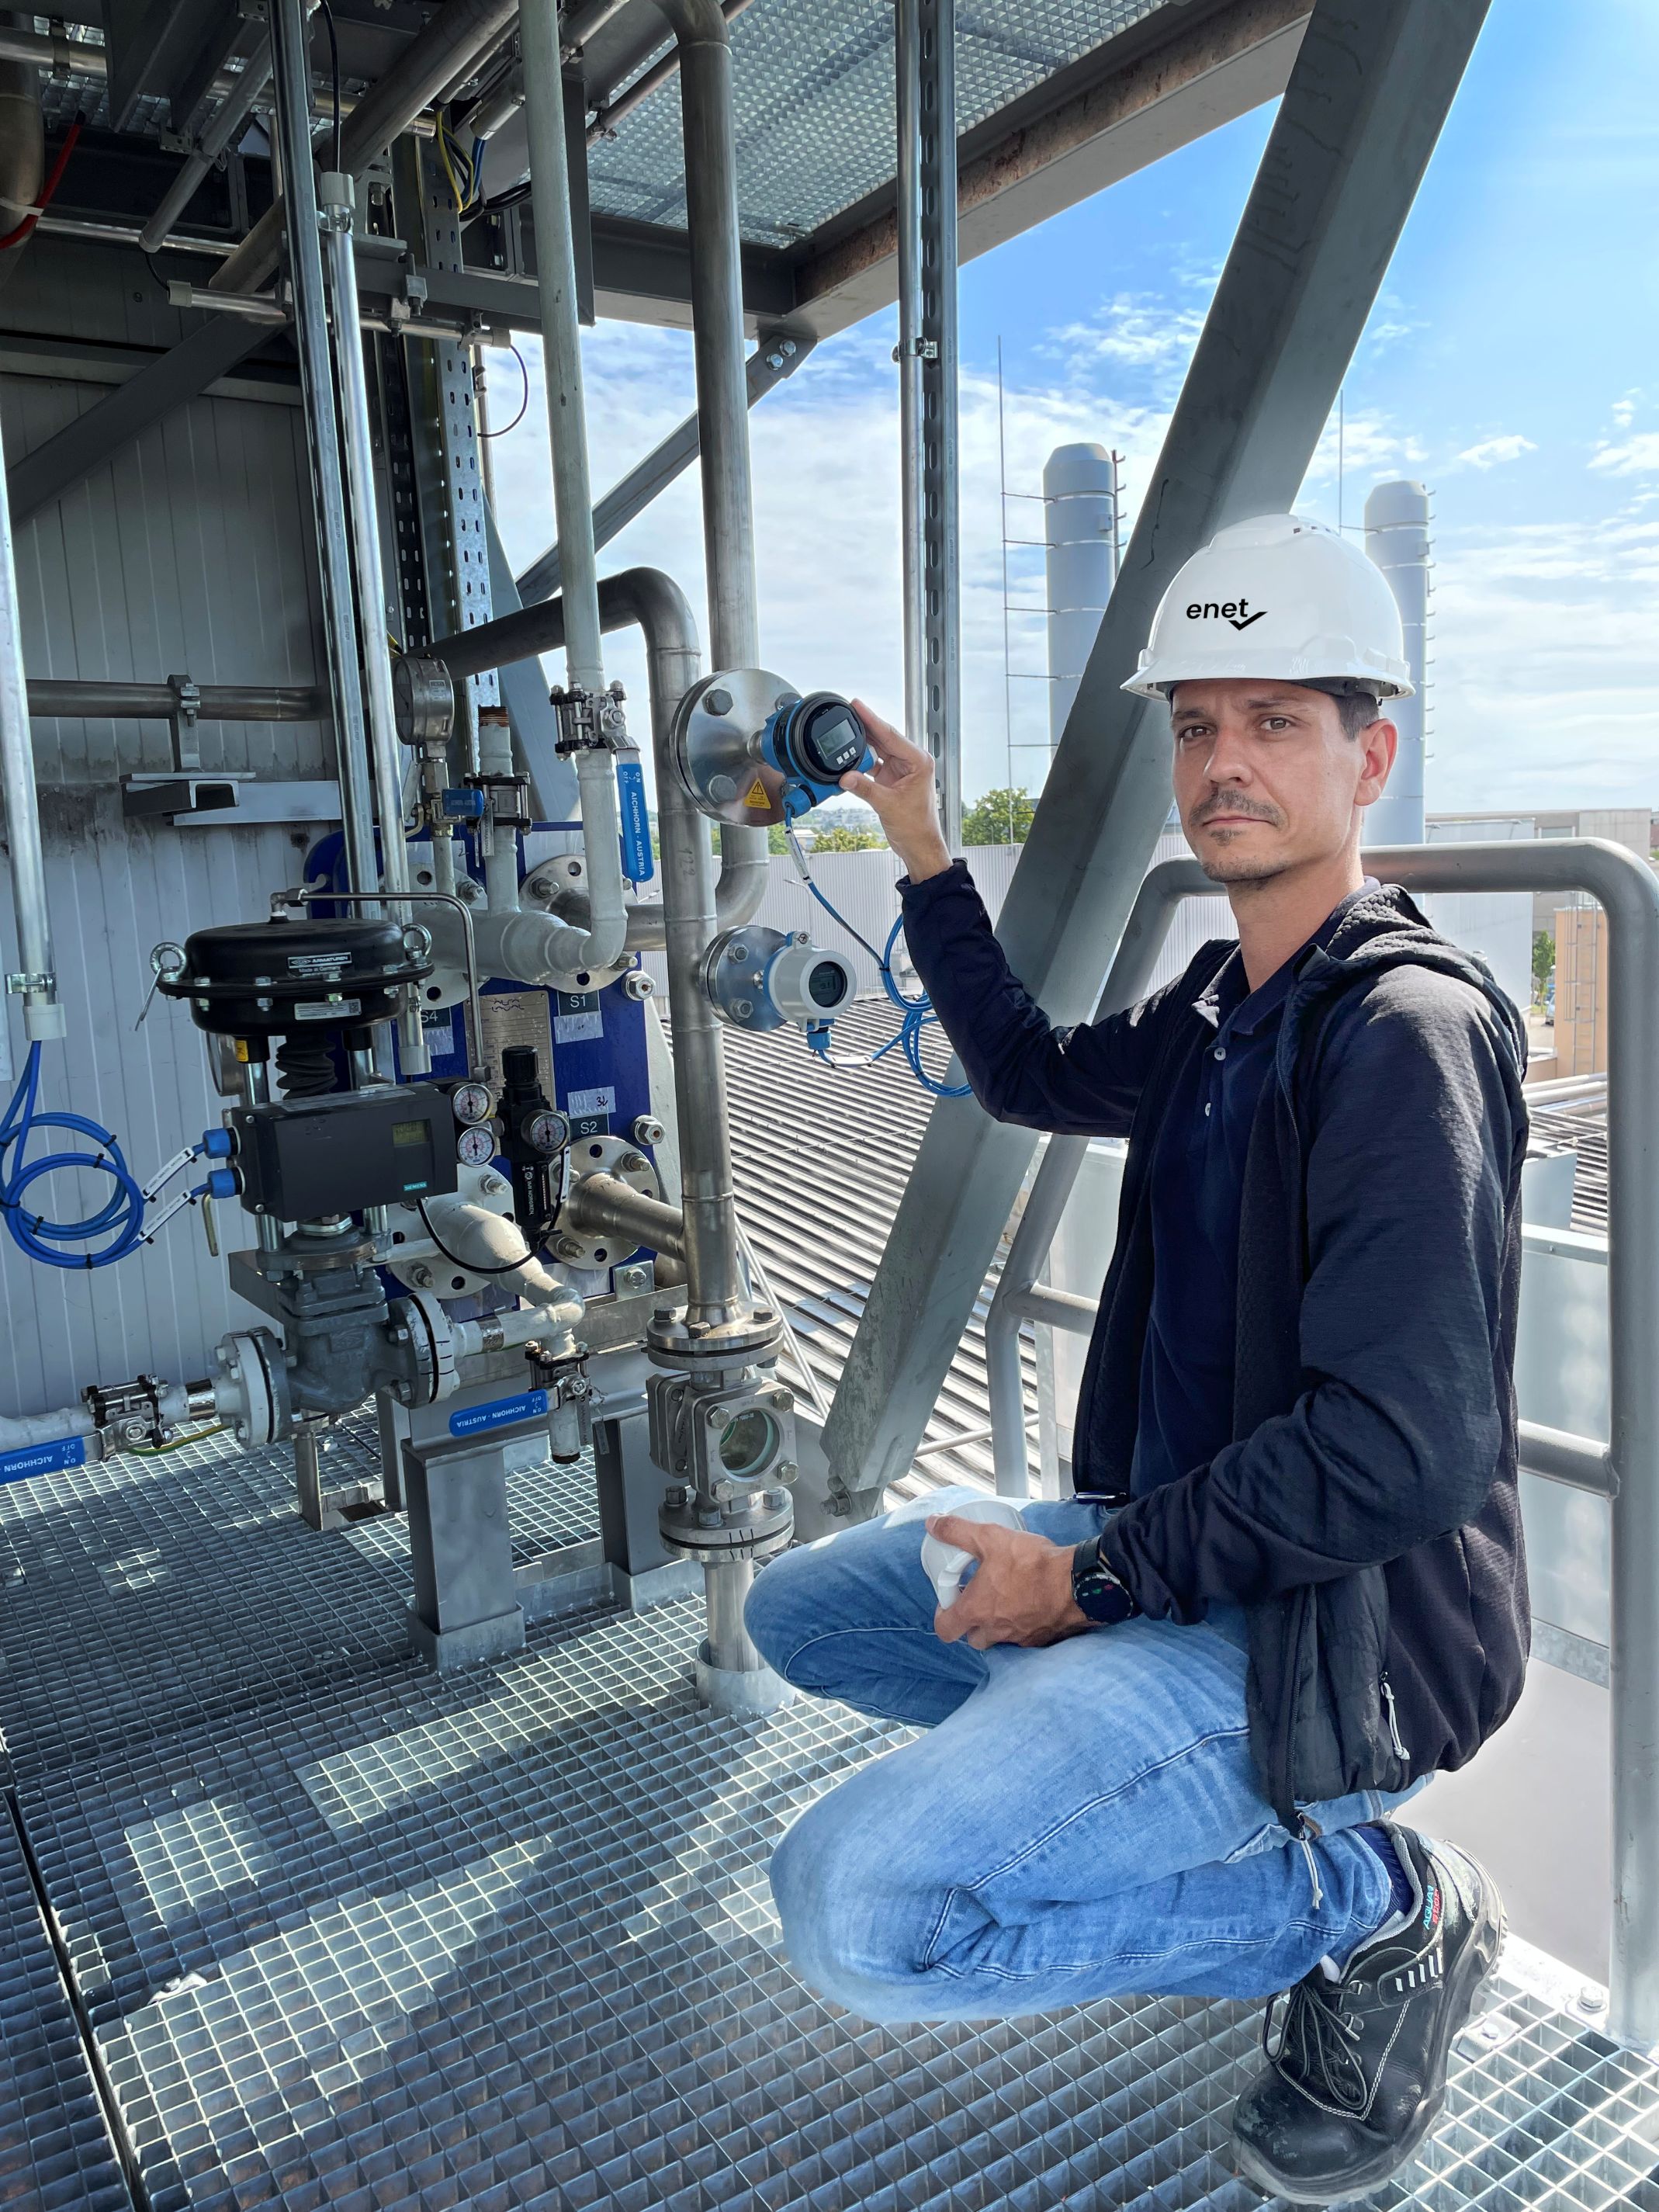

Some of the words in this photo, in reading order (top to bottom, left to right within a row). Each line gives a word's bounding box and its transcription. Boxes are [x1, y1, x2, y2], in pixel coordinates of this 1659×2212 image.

[1186, 598, 1249, 619] enet
[635, 771, 641, 783] ON
[631, 791, 641, 834] AICHHORN
[636, 840, 646, 876] AUSTRIA
[570, 996, 586, 1007] S1
[421, 1010, 438, 1023] S4
[580, 1121, 598, 1135] S2
[492, 1405, 526, 1419] AICHHORN
[456, 1415, 487, 1428] AUSTRIA
[61, 1443, 75, 1451] OFF
[4, 1455, 53, 1472] AICHHORN
[1423, 1891, 1433, 1930] AQUA
